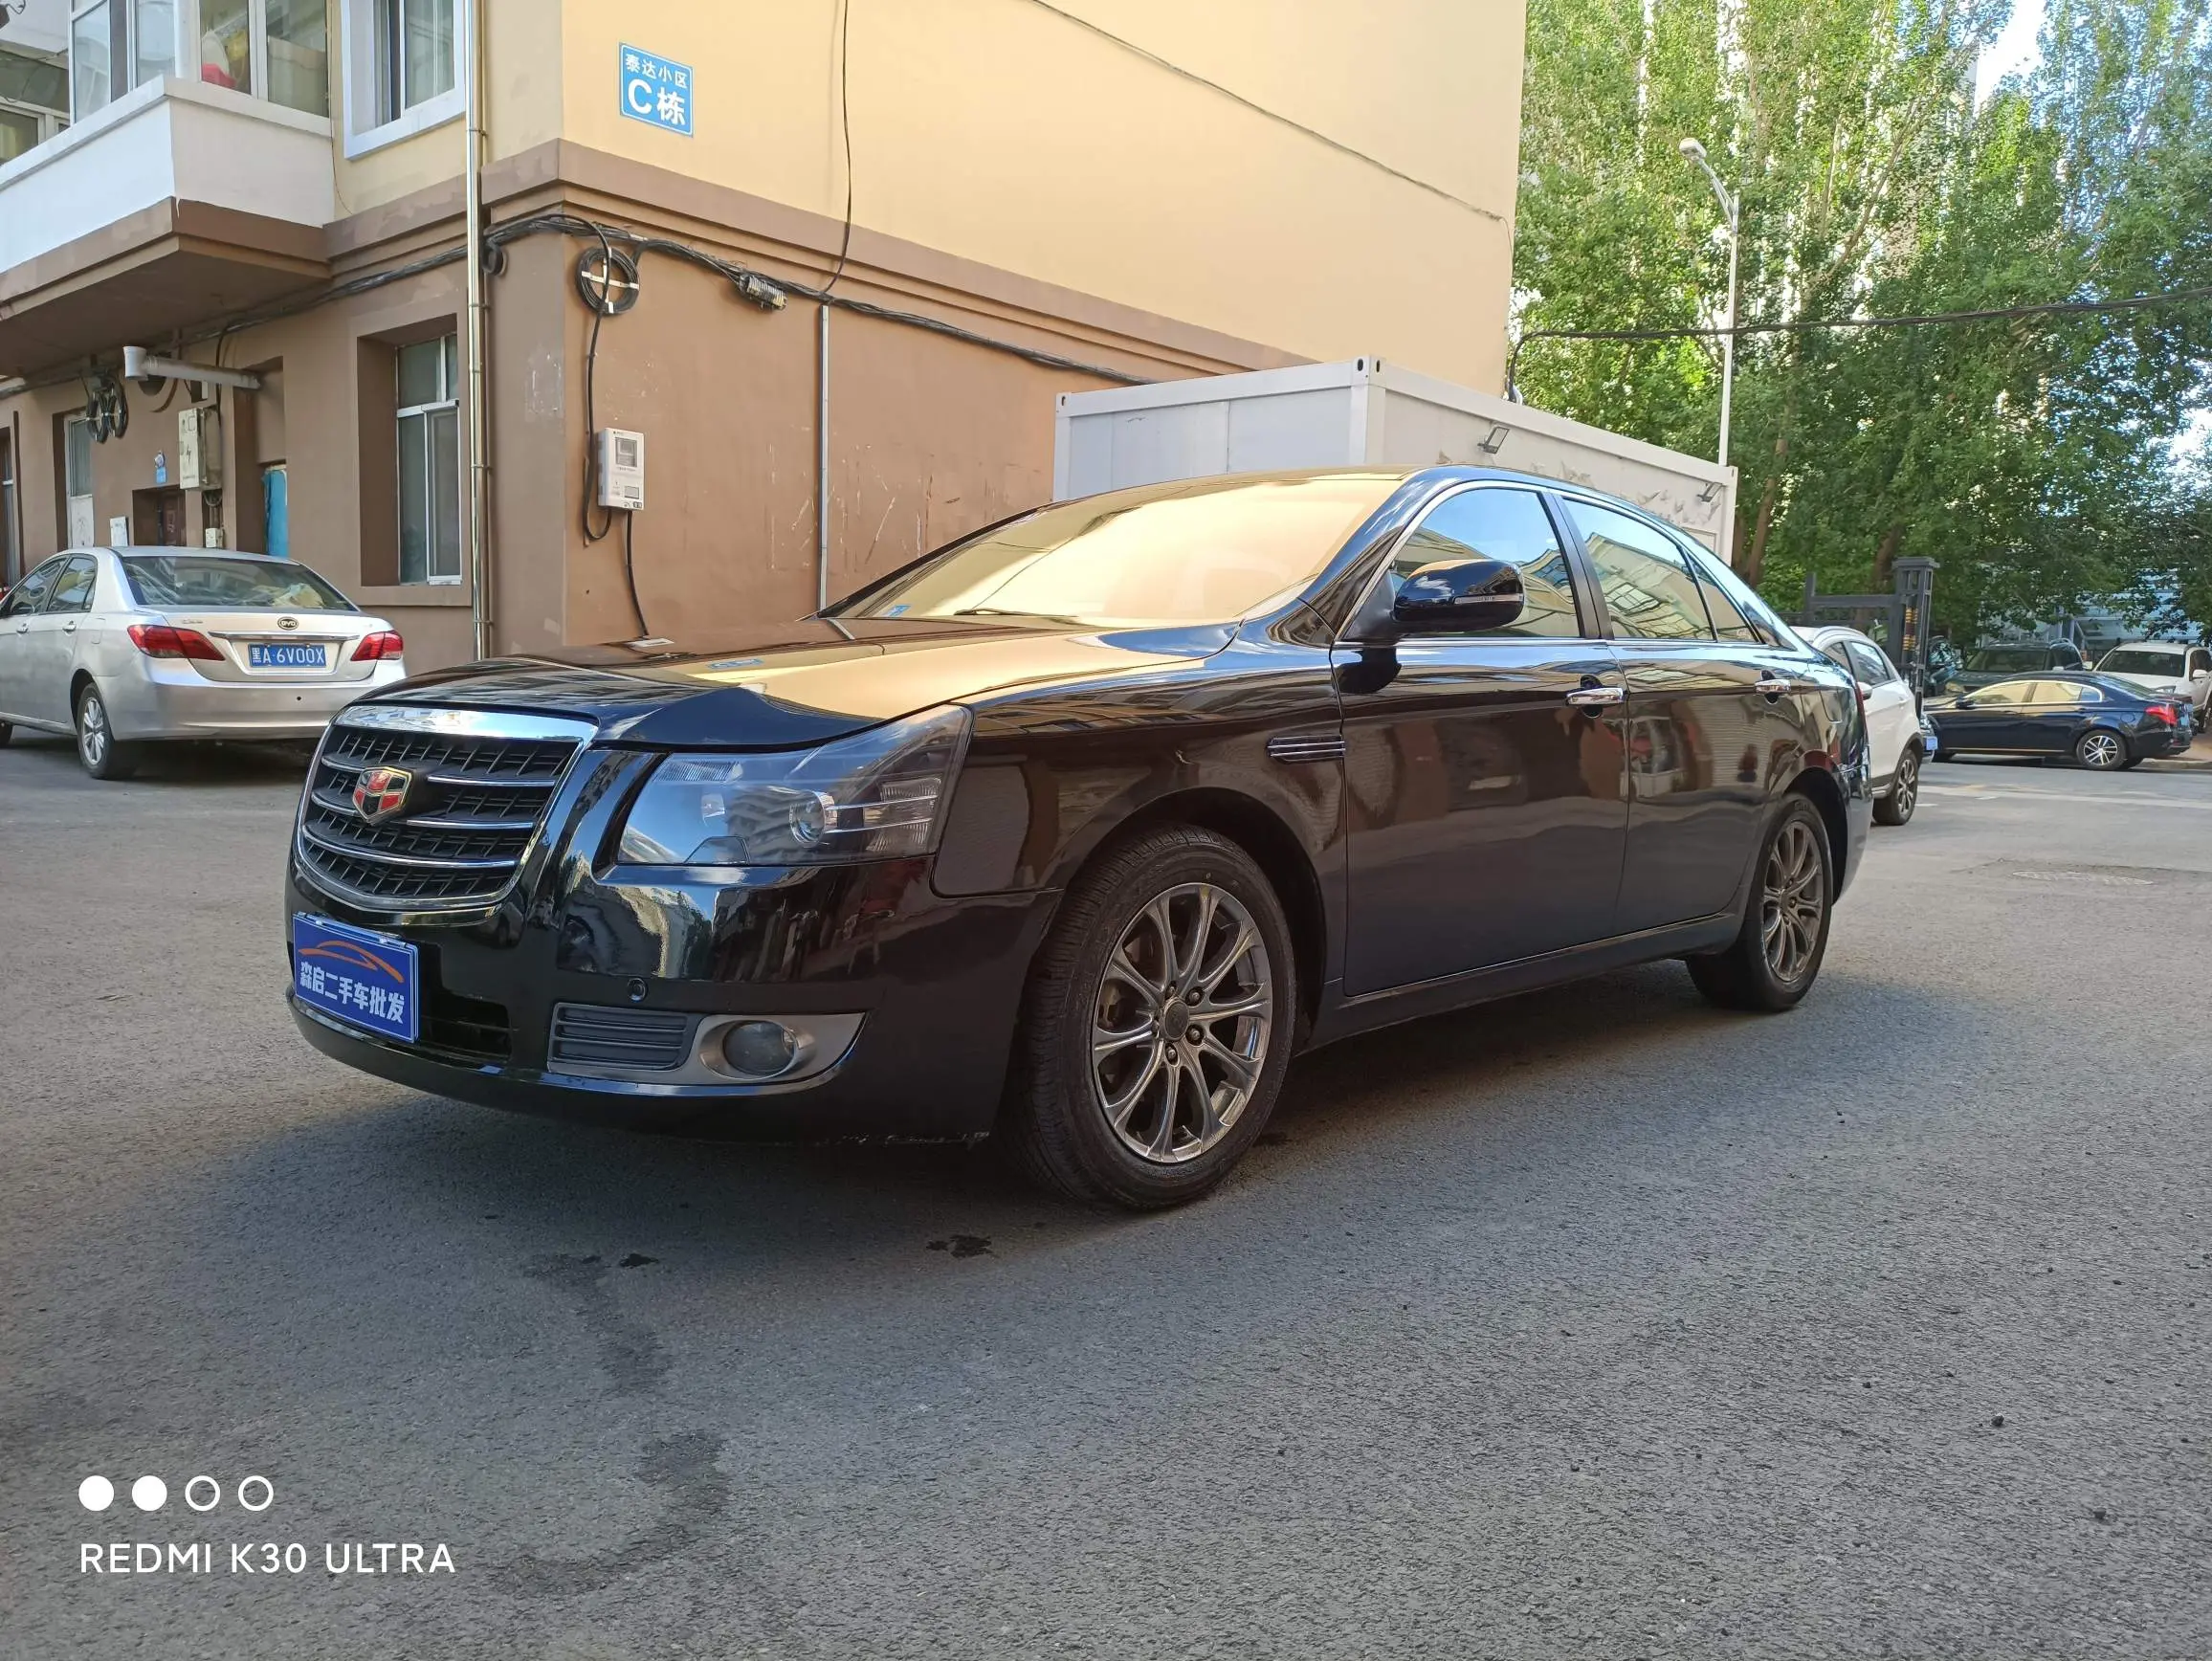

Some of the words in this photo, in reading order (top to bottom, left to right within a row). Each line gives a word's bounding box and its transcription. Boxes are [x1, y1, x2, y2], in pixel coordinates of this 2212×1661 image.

[625, 54, 687, 89] 泰达小区
[628, 78, 686, 125] C栋
